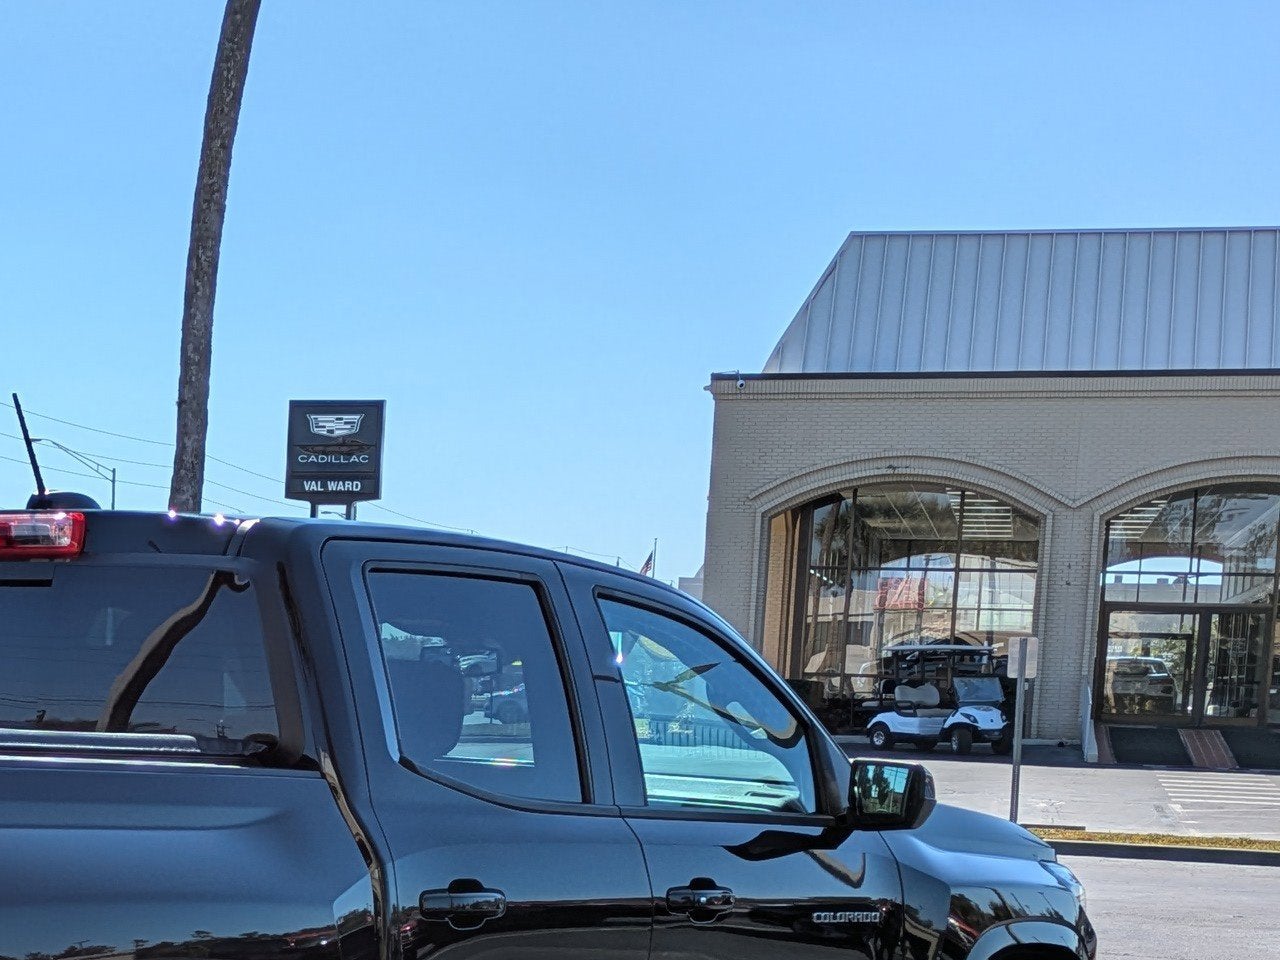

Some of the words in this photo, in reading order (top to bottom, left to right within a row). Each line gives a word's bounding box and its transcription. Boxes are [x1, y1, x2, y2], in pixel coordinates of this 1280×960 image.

[298, 455, 369, 463] CADILLAC
[303, 481, 324, 491] VAL
[327, 481, 361, 491] WARD
[813, 912, 880, 923] COLORADO
